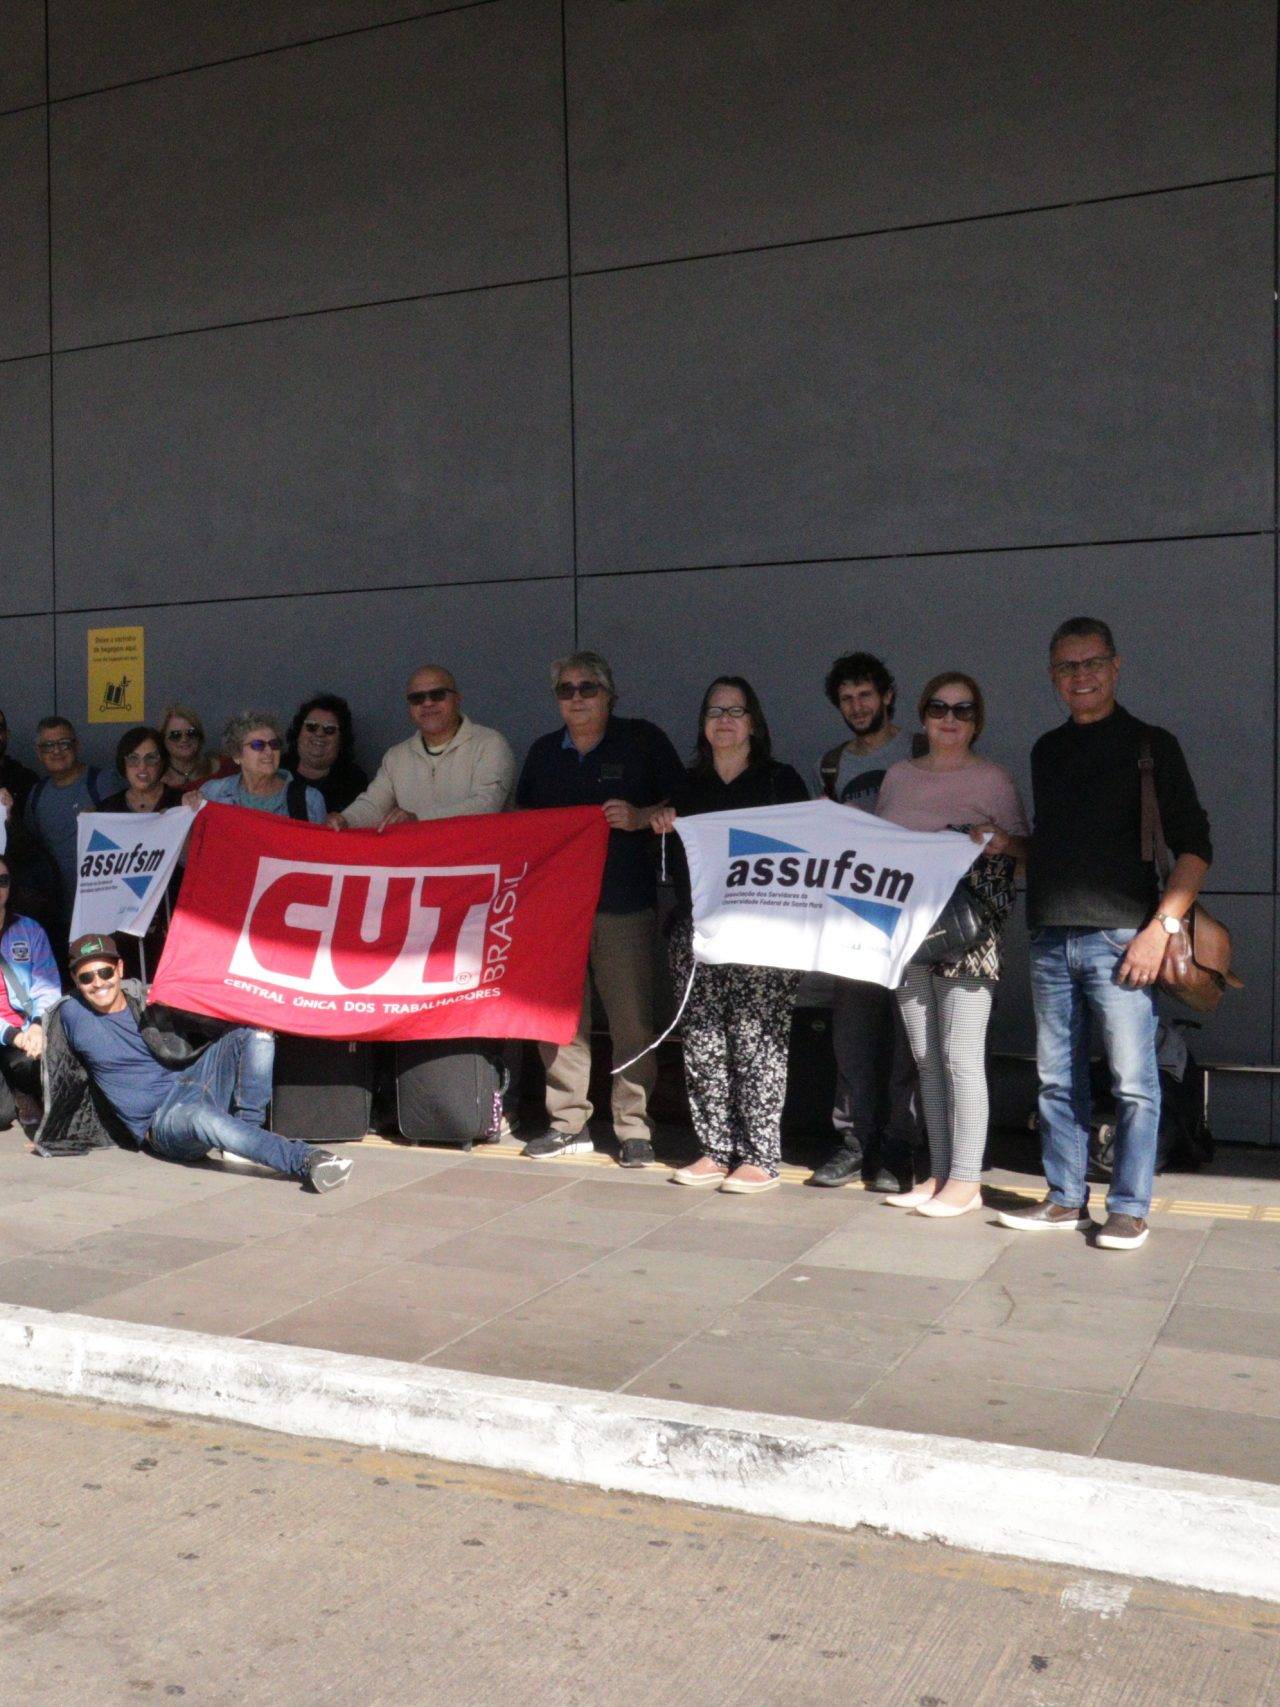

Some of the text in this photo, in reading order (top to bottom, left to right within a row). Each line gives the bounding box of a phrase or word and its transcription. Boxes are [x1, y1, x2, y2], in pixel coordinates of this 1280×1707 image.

[80, 842, 166, 878] assufsm
[725, 849, 915, 904] assufsm
[248, 871, 496, 990] CUT
[483, 861, 528, 984] BRASIL
[223, 977, 501, 1014] CENTRAL ÚNICA DOS TRABALHADORES
